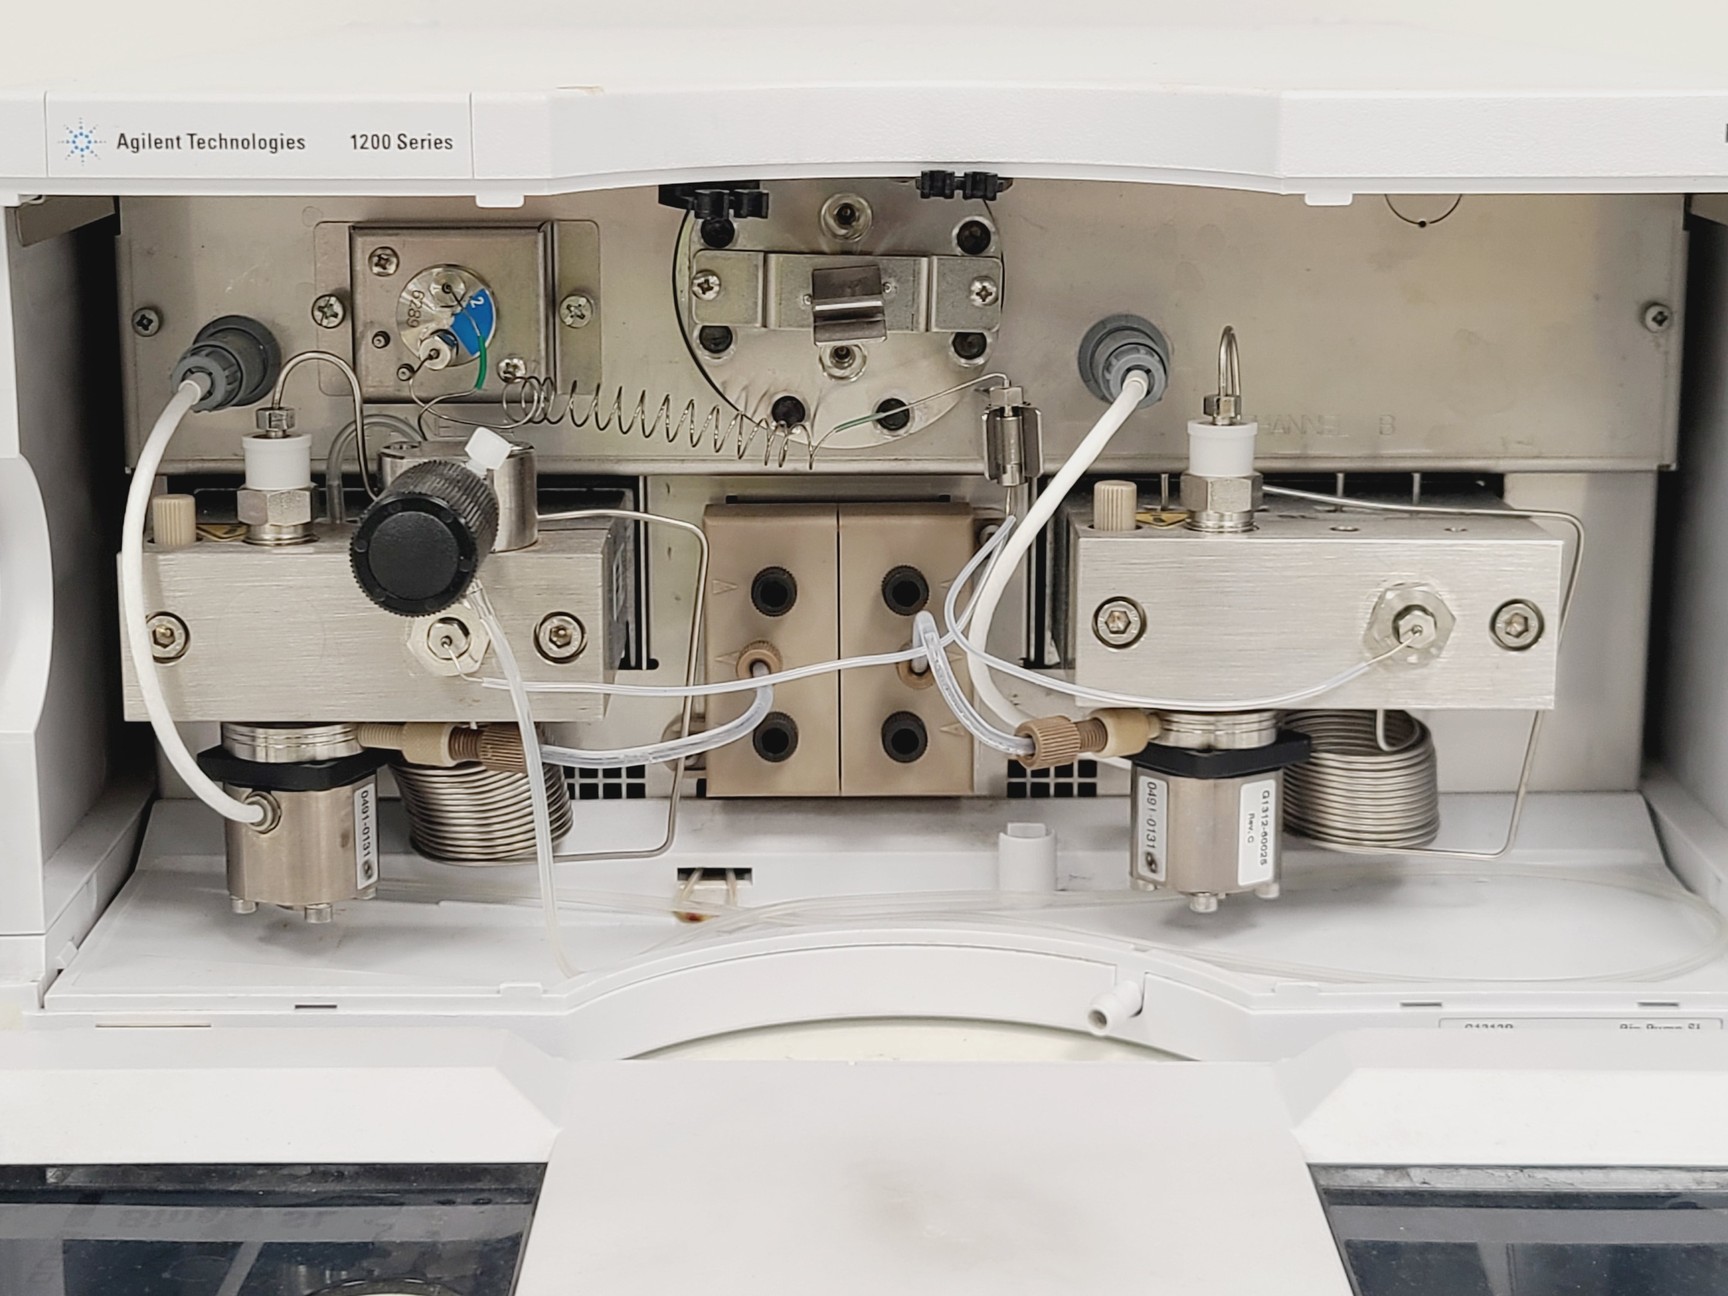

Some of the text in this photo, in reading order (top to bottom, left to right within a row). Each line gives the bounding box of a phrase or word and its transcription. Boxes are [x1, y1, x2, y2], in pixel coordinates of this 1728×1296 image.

[116, 132, 307, 154] Agilent Technologies
[350, 132, 454, 151] 1200 Series
[470, 296, 485, 308] 2
[1379, 414, 1397, 436] B
